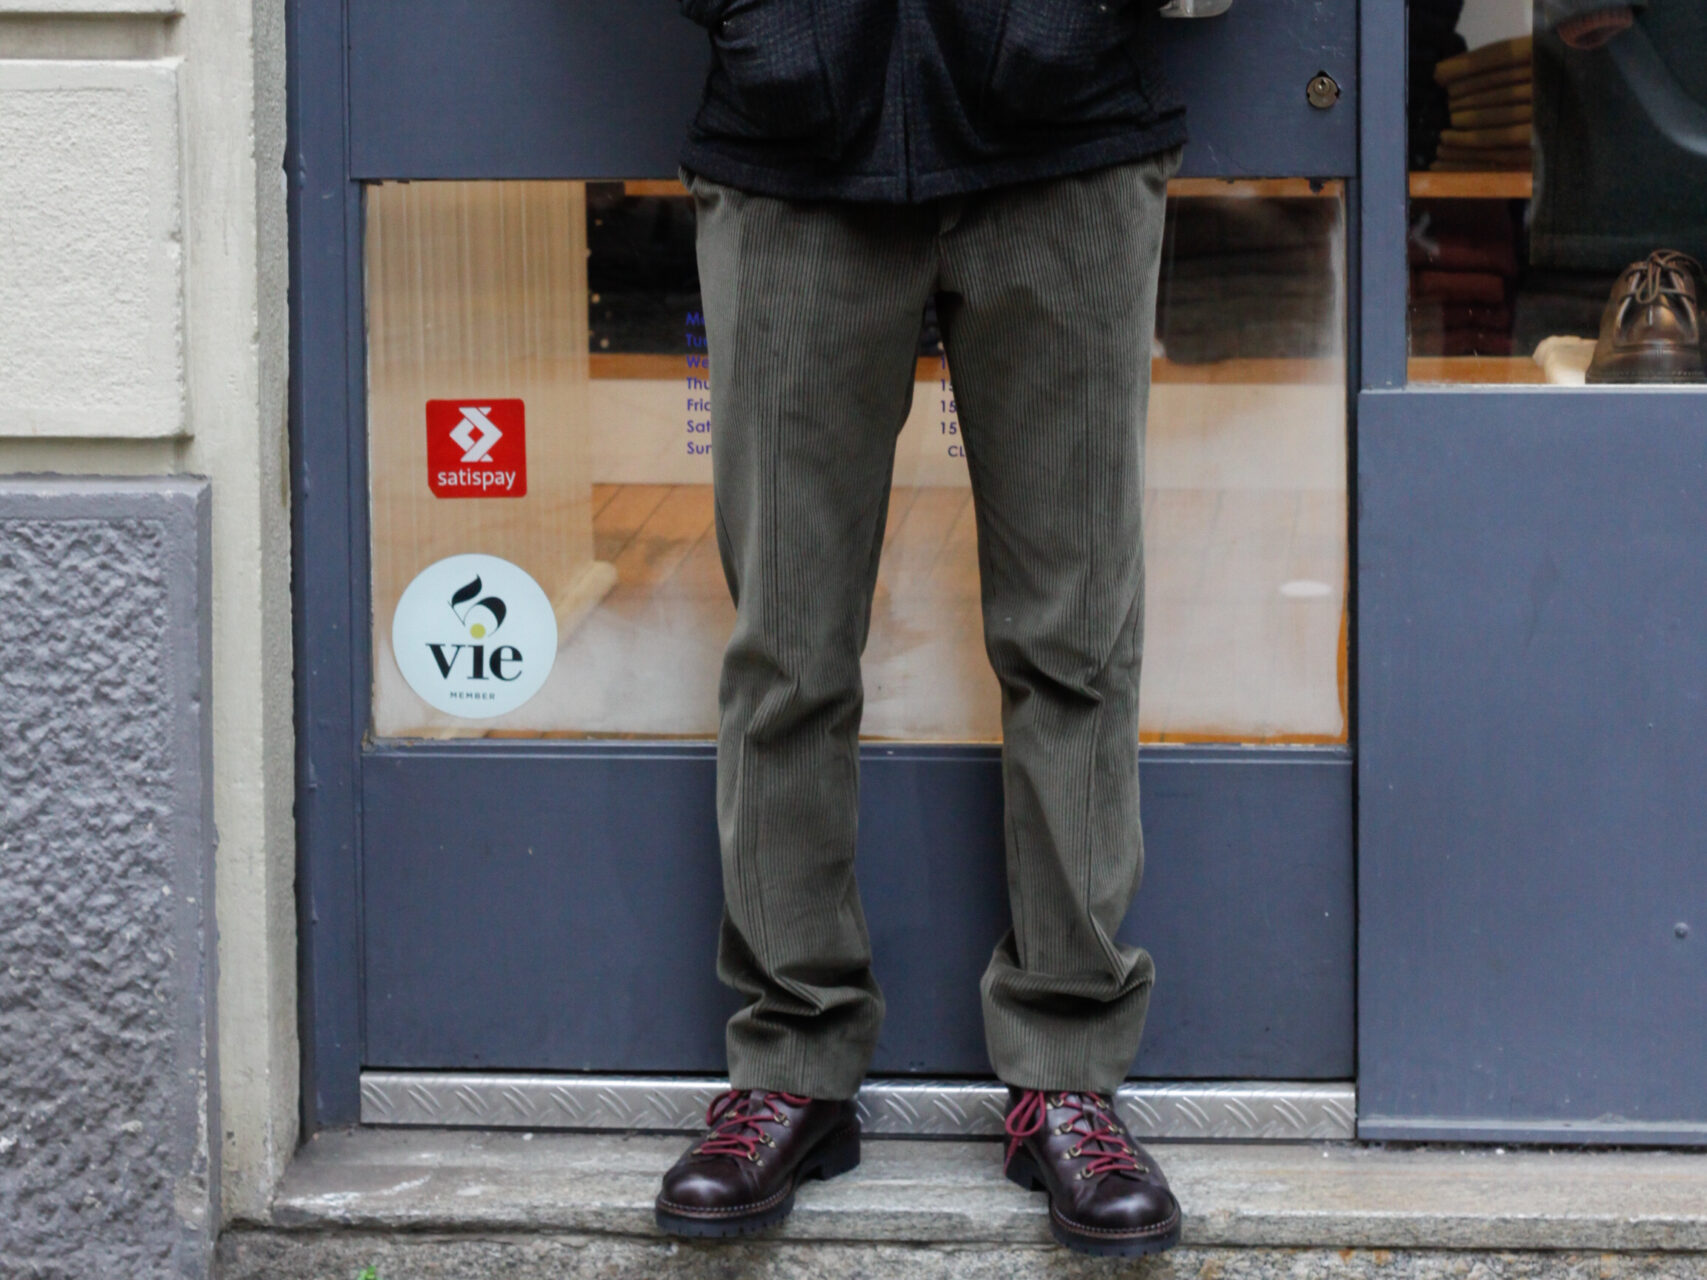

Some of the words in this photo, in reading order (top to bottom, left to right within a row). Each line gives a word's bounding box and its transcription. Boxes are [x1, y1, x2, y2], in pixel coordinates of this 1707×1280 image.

[437, 467, 516, 491] satispay
[425, 642, 523, 682] vie
[450, 691, 495, 700] MEMBER
